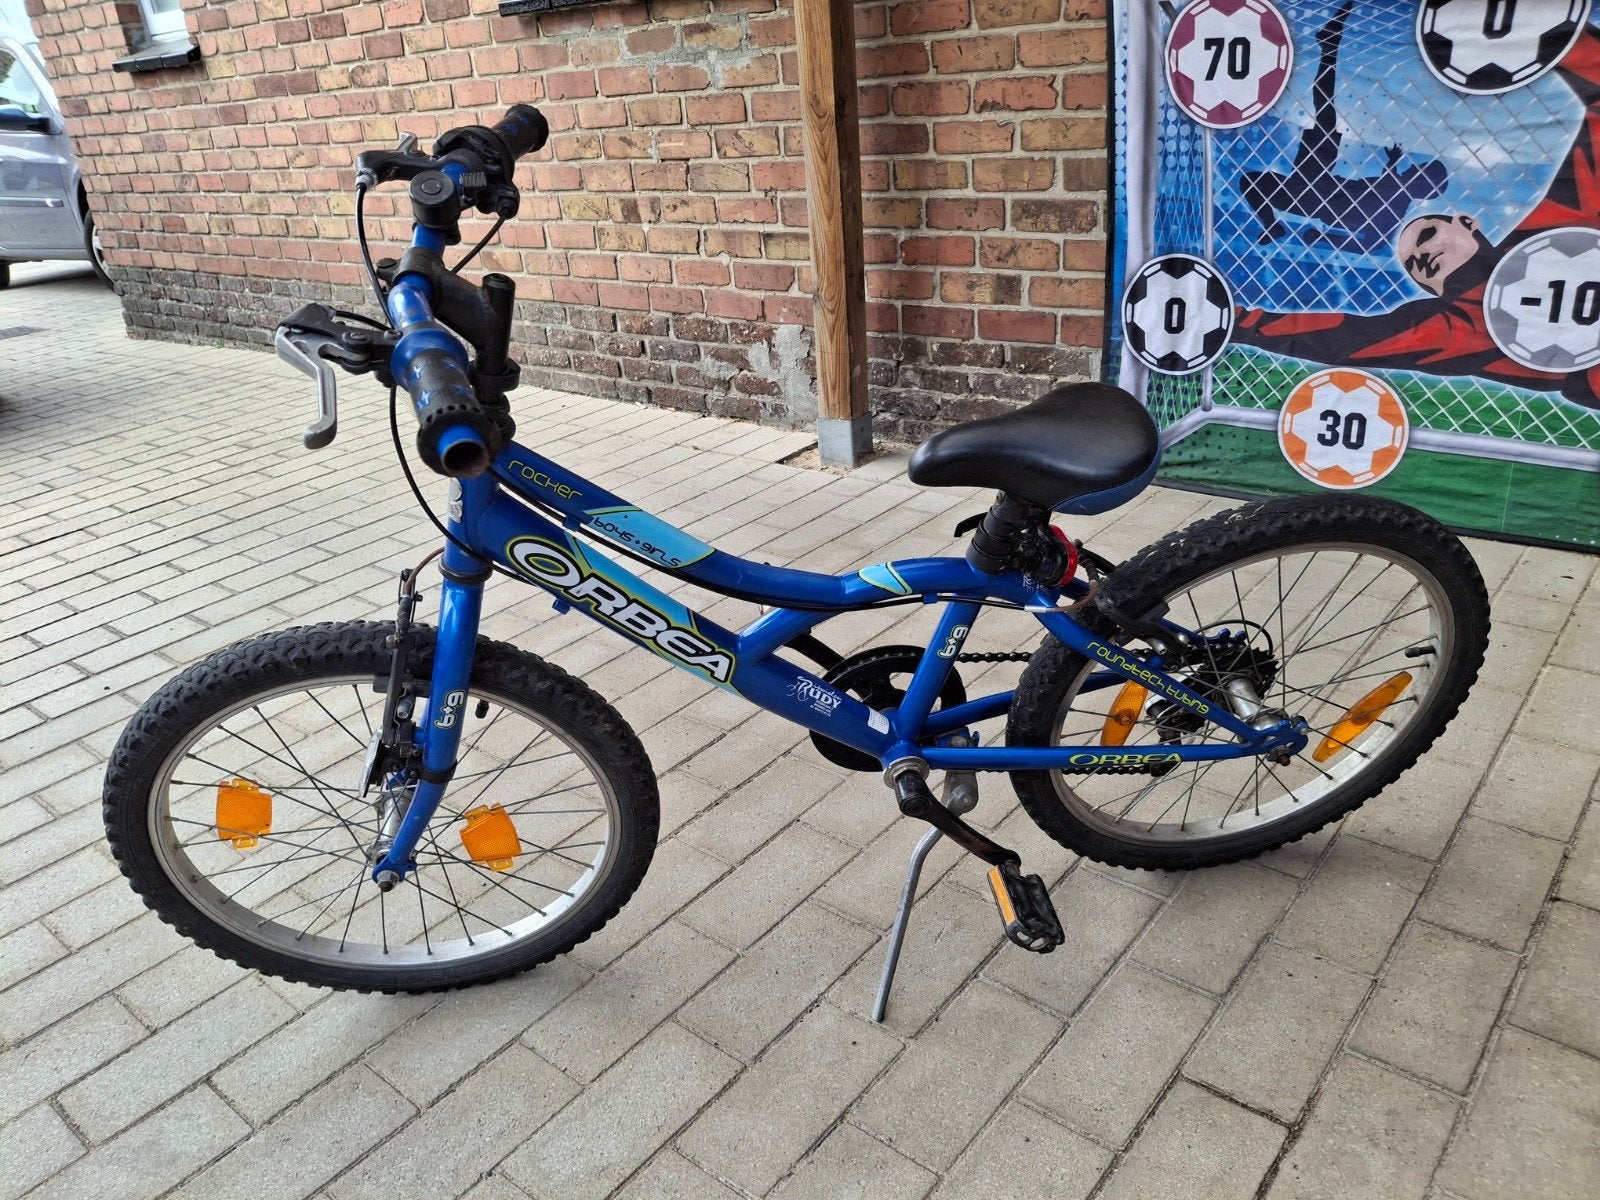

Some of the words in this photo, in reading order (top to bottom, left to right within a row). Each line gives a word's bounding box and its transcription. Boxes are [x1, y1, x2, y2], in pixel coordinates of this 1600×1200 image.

[1203, 36, 1251, 81] 70
[1163, 297, 1187, 335] 0
[1519, 279, 1600, 326] -10
[1317, 408, 1368, 451] 30
[507, 460, 583, 500] rocker
[511, 540, 732, 682] ORBEA
[1086, 641, 1165, 691] roundtech
[1166, 684, 1210, 715] tubing
[1069, 752, 1182, 766] ORBEA
